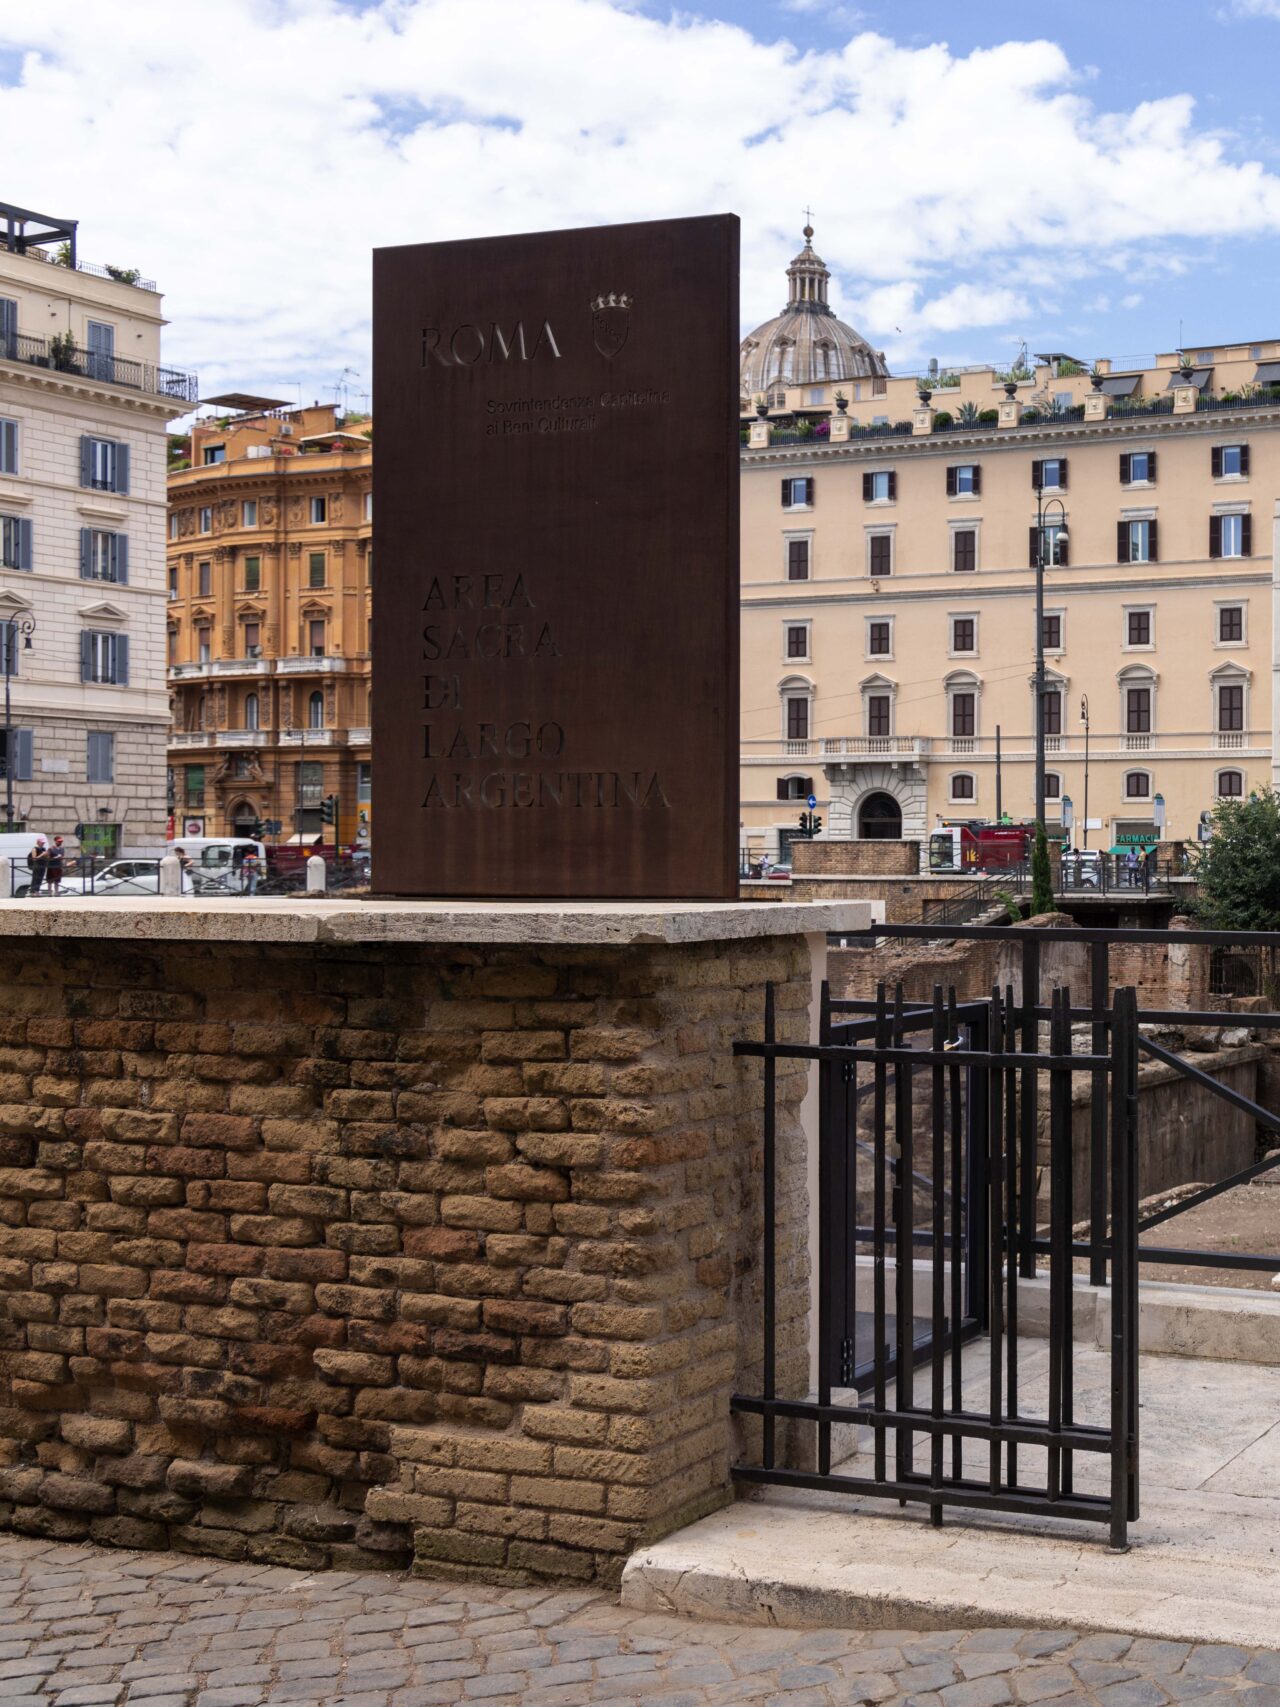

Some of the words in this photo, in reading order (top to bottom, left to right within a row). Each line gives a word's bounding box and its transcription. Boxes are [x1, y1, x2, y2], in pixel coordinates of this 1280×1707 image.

[420, 317, 562, 368] ROMA
[486, 393, 594, 415] Sovrintendenza
[599, 387, 671, 408] Capitolina
[486, 422, 498, 436] ai
[503, 418, 534, 434] Beni
[538, 415, 597, 433] Culturali
[421, 572, 537, 611] AREA
[422, 622, 563, 661] SACRA
[420, 672, 463, 710] DI
[420, 720, 565, 759] LARGO
[420, 770, 673, 808] ARGENTINA
